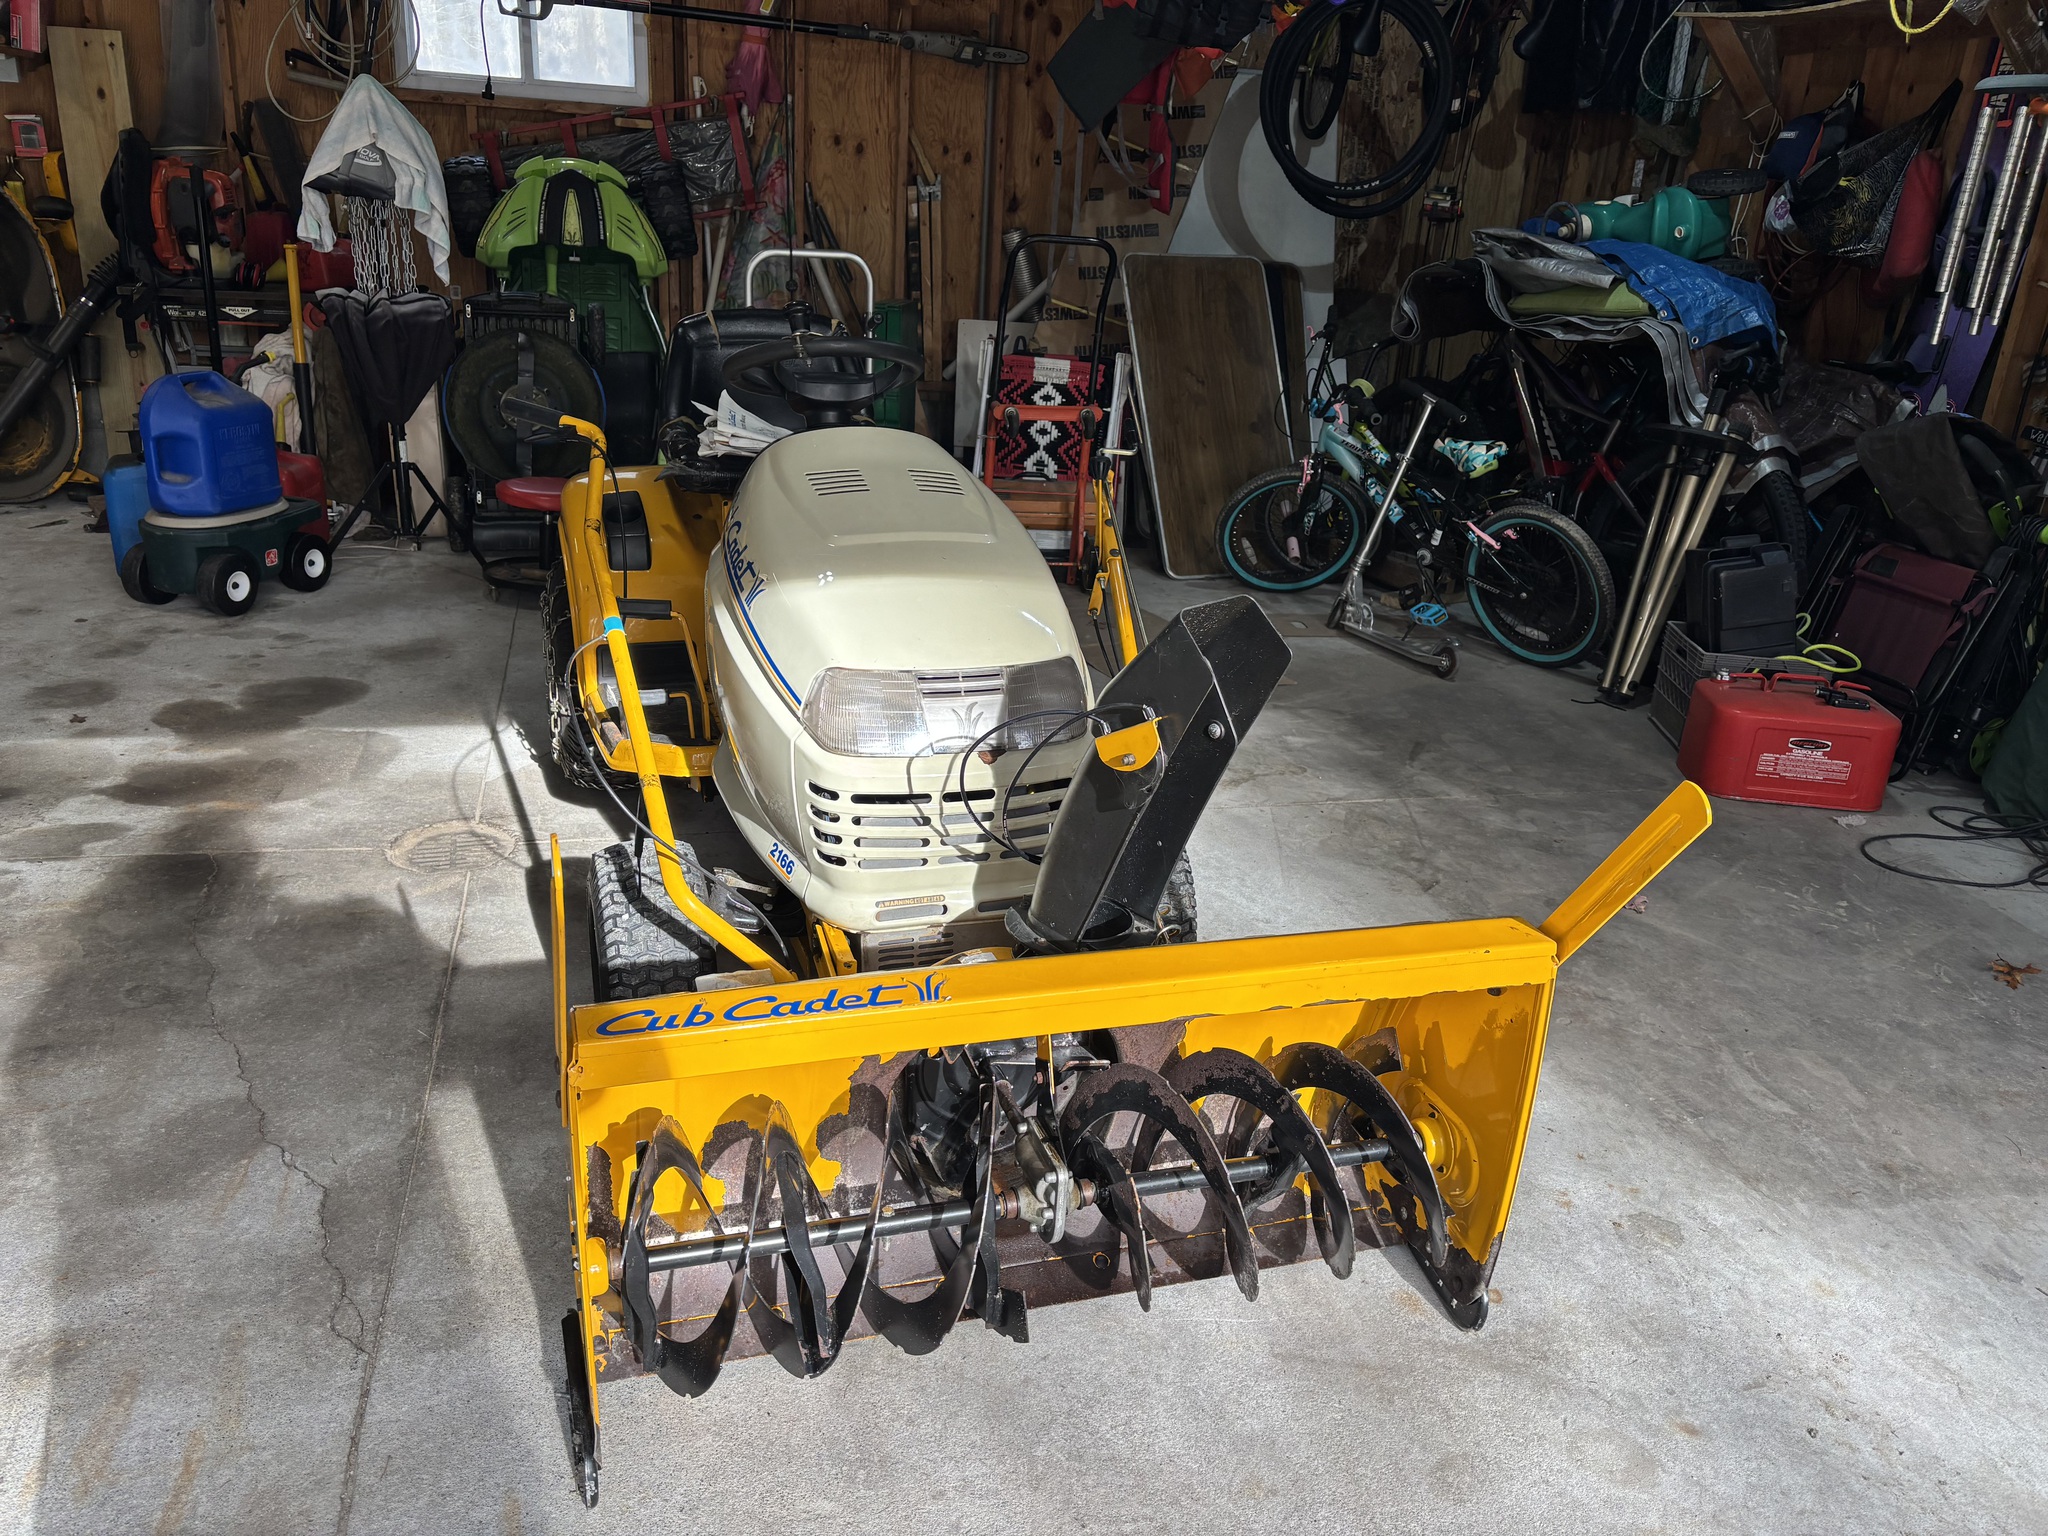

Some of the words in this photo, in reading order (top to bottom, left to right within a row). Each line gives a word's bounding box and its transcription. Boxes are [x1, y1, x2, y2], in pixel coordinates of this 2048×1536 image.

[1333, 179, 1380, 191] MAXXIS
[1096, 223, 1145, 239] WESTIN
[727, 520, 756, 593] Cadet
[769, 842, 796, 876] 2166
[884, 897, 914, 907] WARNING
[596, 1003, 714, 1036] Cub
[723, 984, 908, 1021] Cadet
